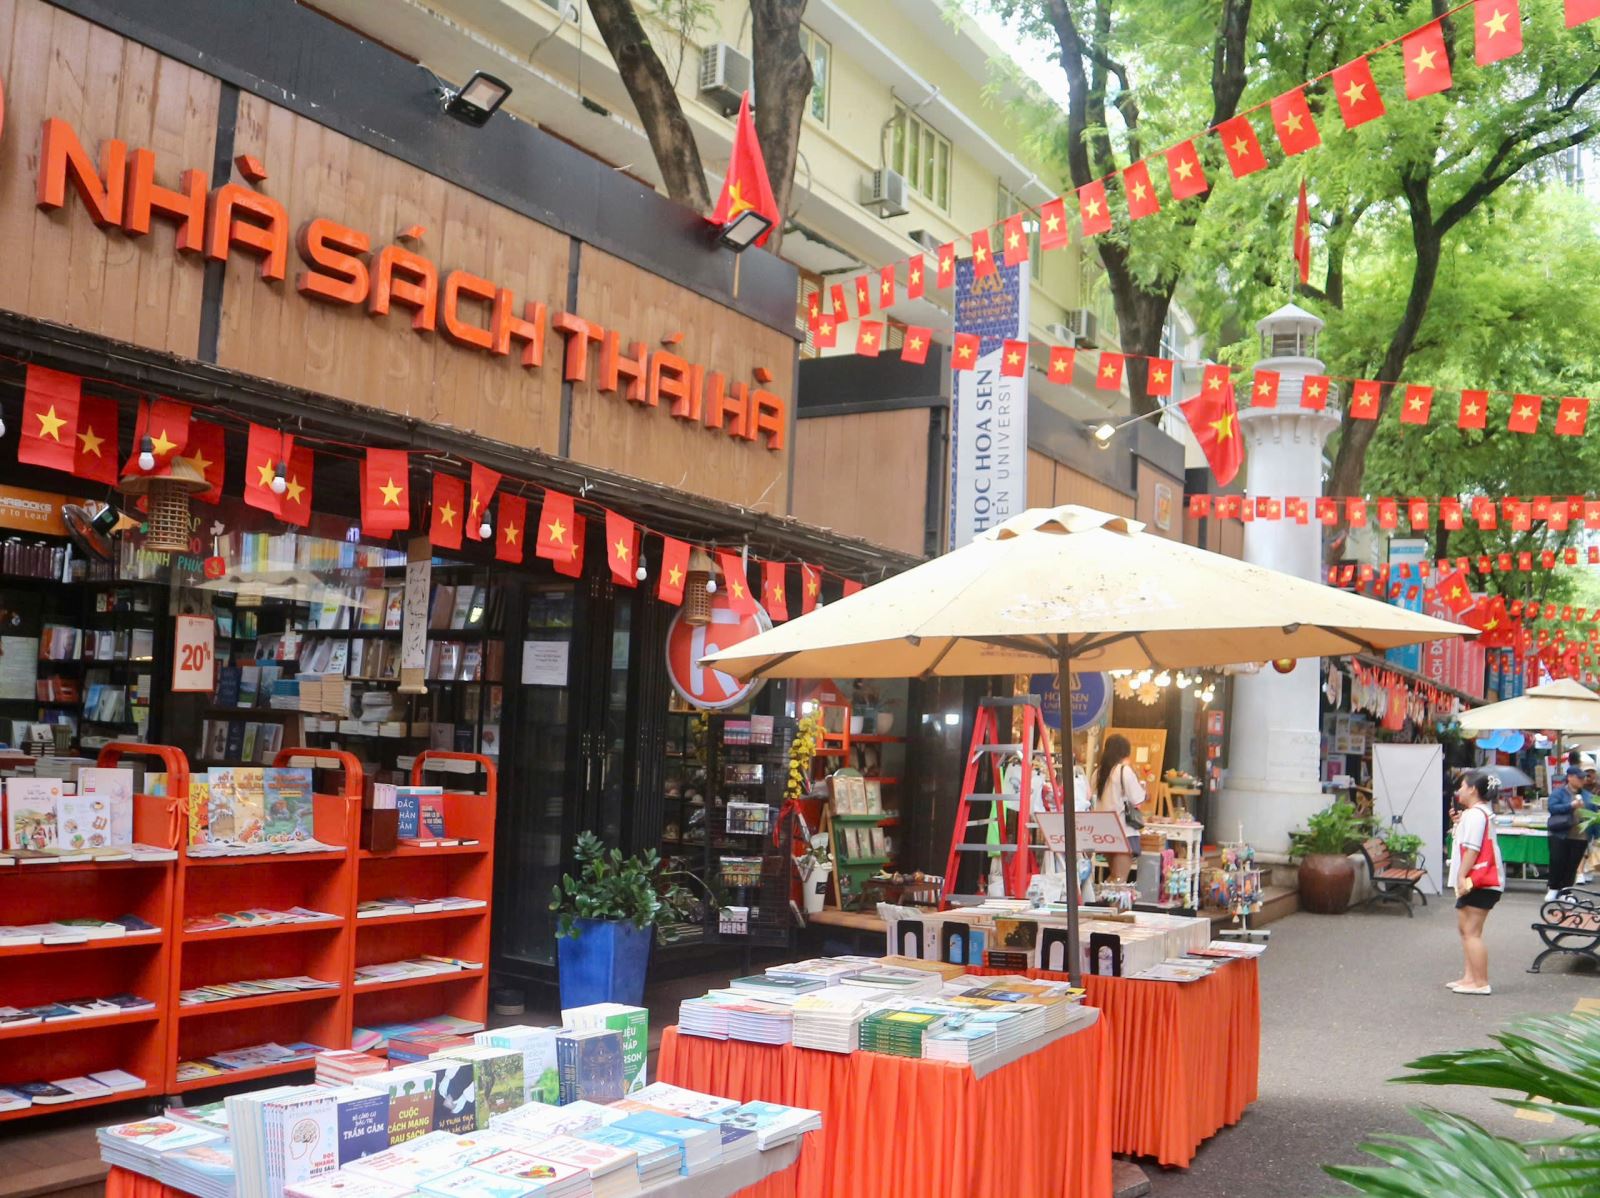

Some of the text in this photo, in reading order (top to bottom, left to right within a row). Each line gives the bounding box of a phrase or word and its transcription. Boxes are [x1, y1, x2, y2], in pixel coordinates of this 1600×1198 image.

[36, 116, 290, 280] NHÀ
[295, 218, 547, 369] SÁCH
[551, 309, 705, 421] THÁI
[703, 365, 785, 451] HÀ
[974, 369, 996, 533] HỌC HOA SEN
[399, 811, 416, 819] HÂN
[622, 1026, 637, 1038] IỆU
[622, 1039, 638, 1051] HÁP
[398, 1106, 420, 1120] CUỘC
[387, 1116, 430, 1134] CÁCH MẠNG
[390, 1134, 406, 1145] RAU
